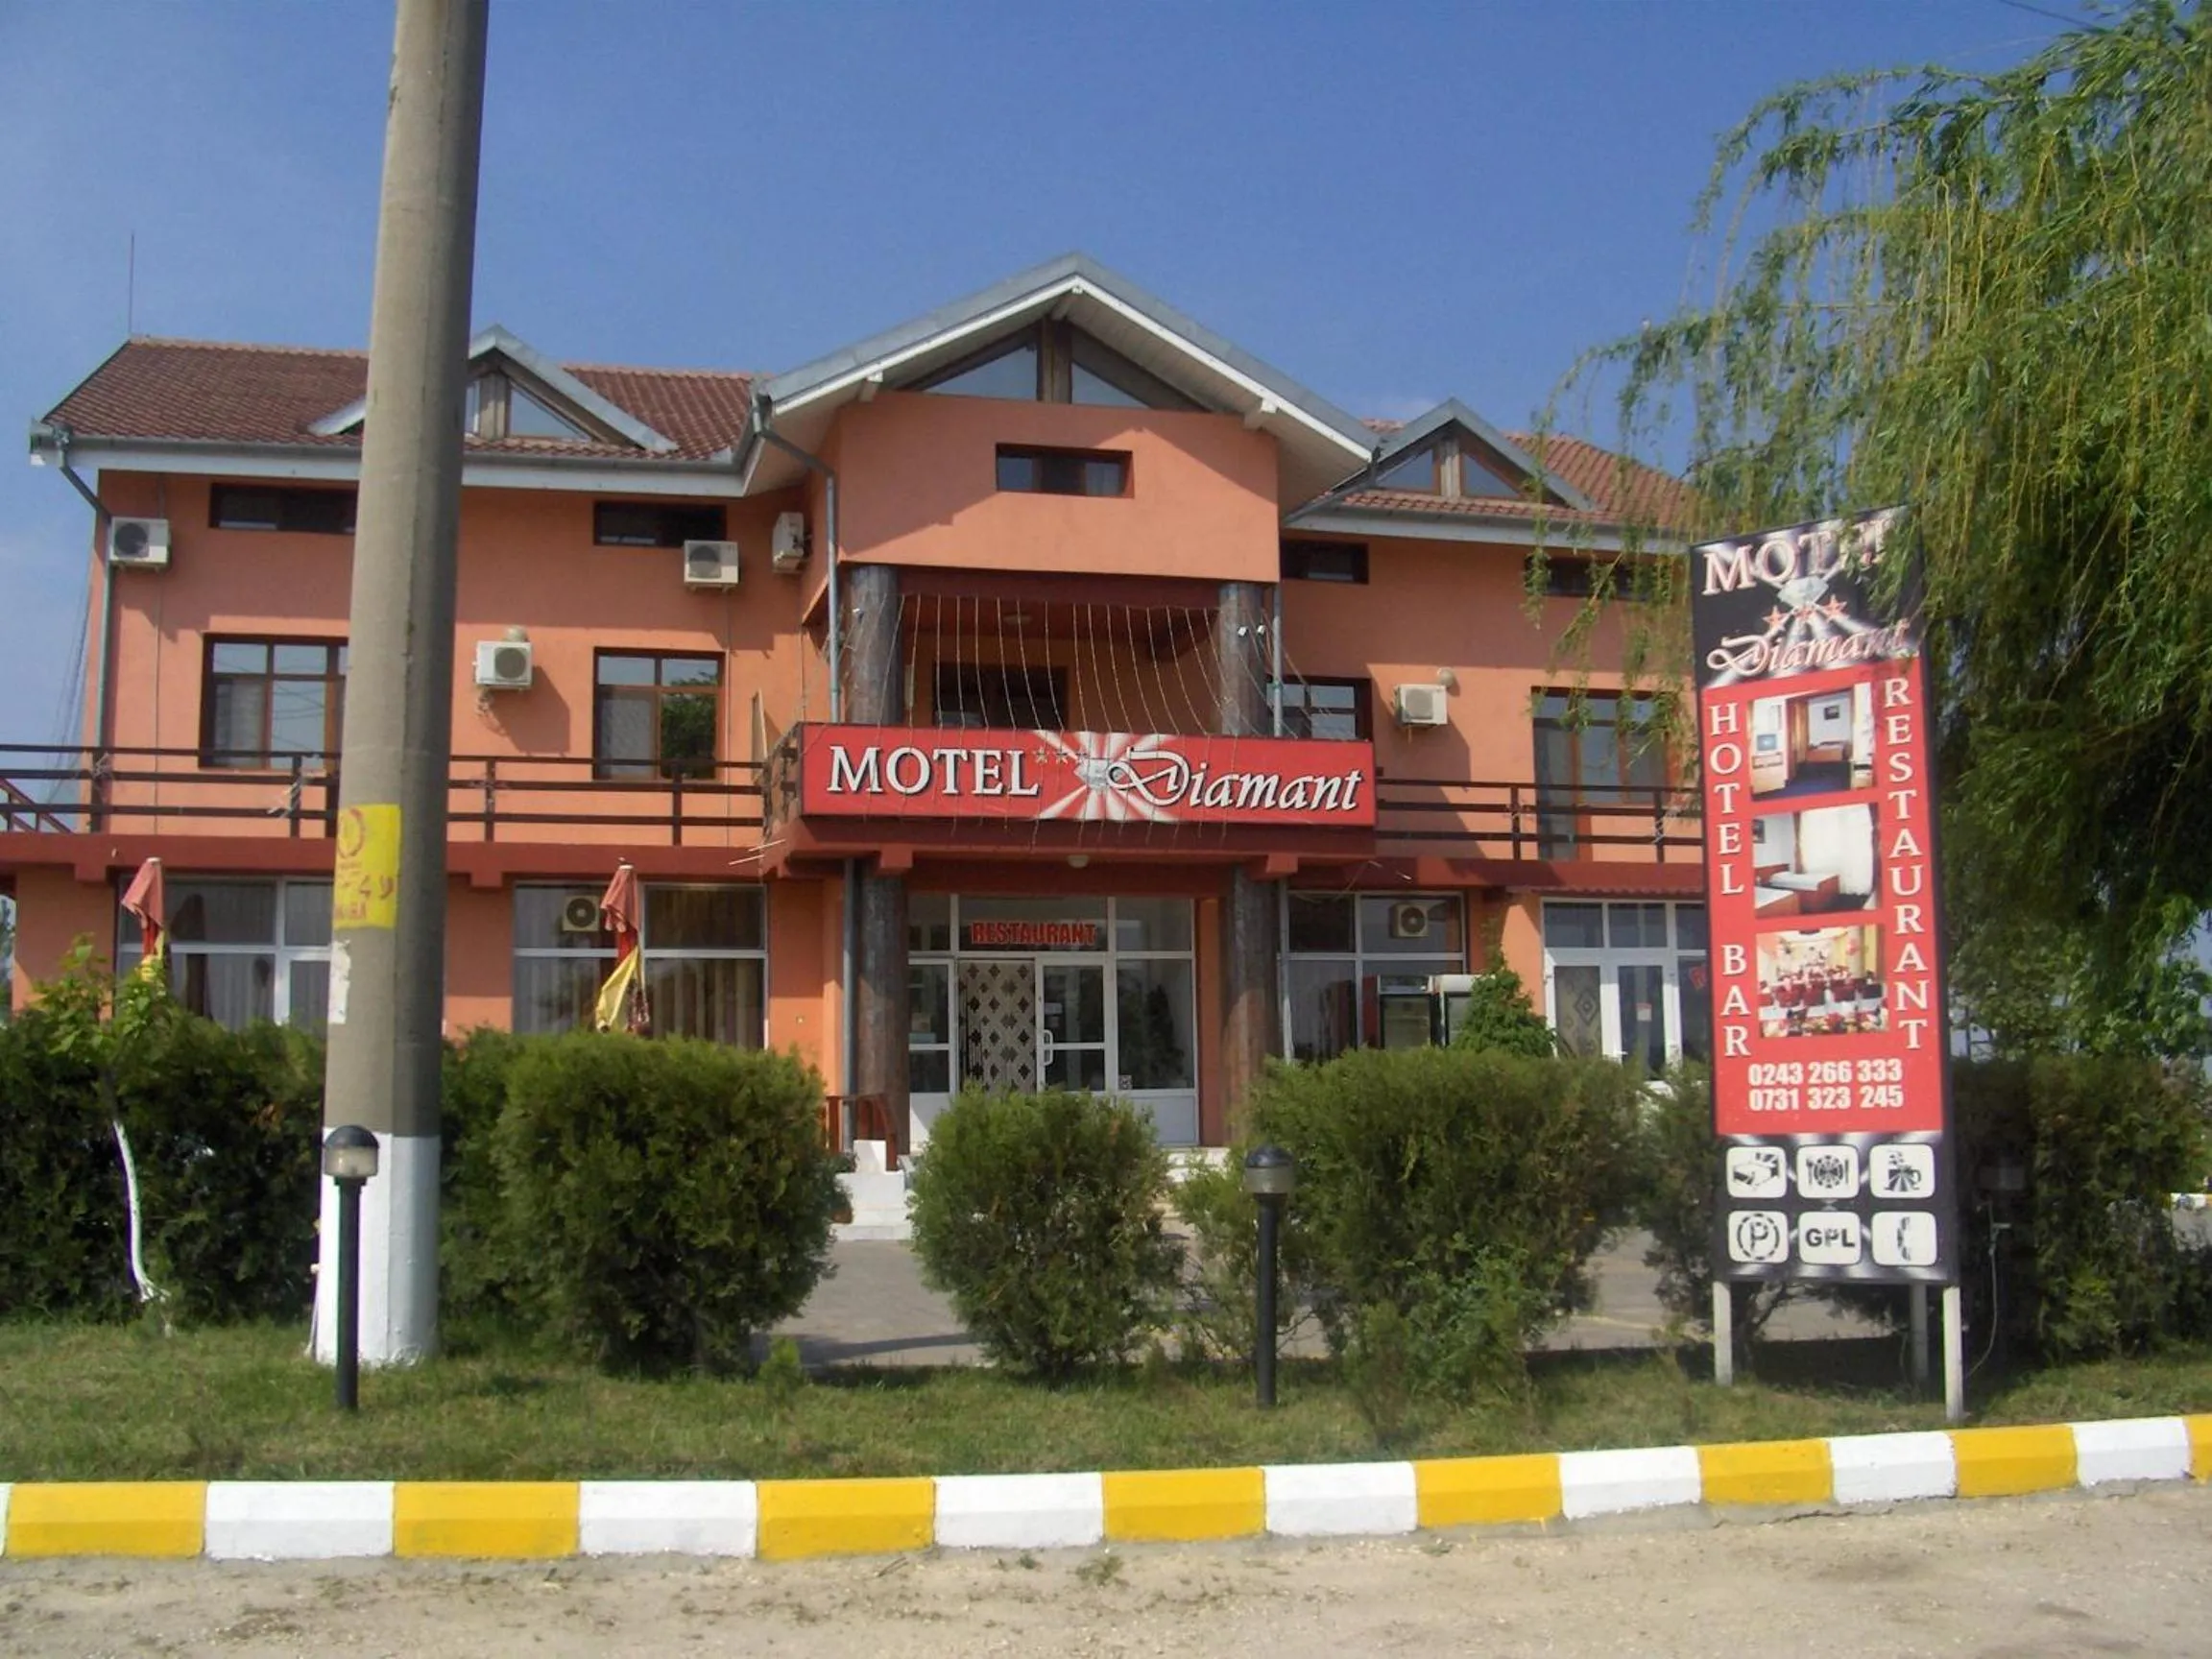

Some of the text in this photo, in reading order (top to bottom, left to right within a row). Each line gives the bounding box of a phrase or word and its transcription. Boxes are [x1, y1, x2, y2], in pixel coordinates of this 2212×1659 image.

[1702, 517, 1896, 595] MOT
[1706, 617, 1910, 676] Diamant
[827, 745, 1361, 810] MOTEL Diamant
[1709, 703, 1752, 1057] HOTEL BAR
[1884, 677, 1928, 1050] RESTAURANT
[971, 921, 1096, 946] RESTAURANT
[1748, 1059, 1903, 1086] 0243 266 333
[1748, 1084, 1904, 1111] 0731 323 245
[1748, 1220, 1769, 1252] P
[1805, 1228, 1855, 1247] GPL
